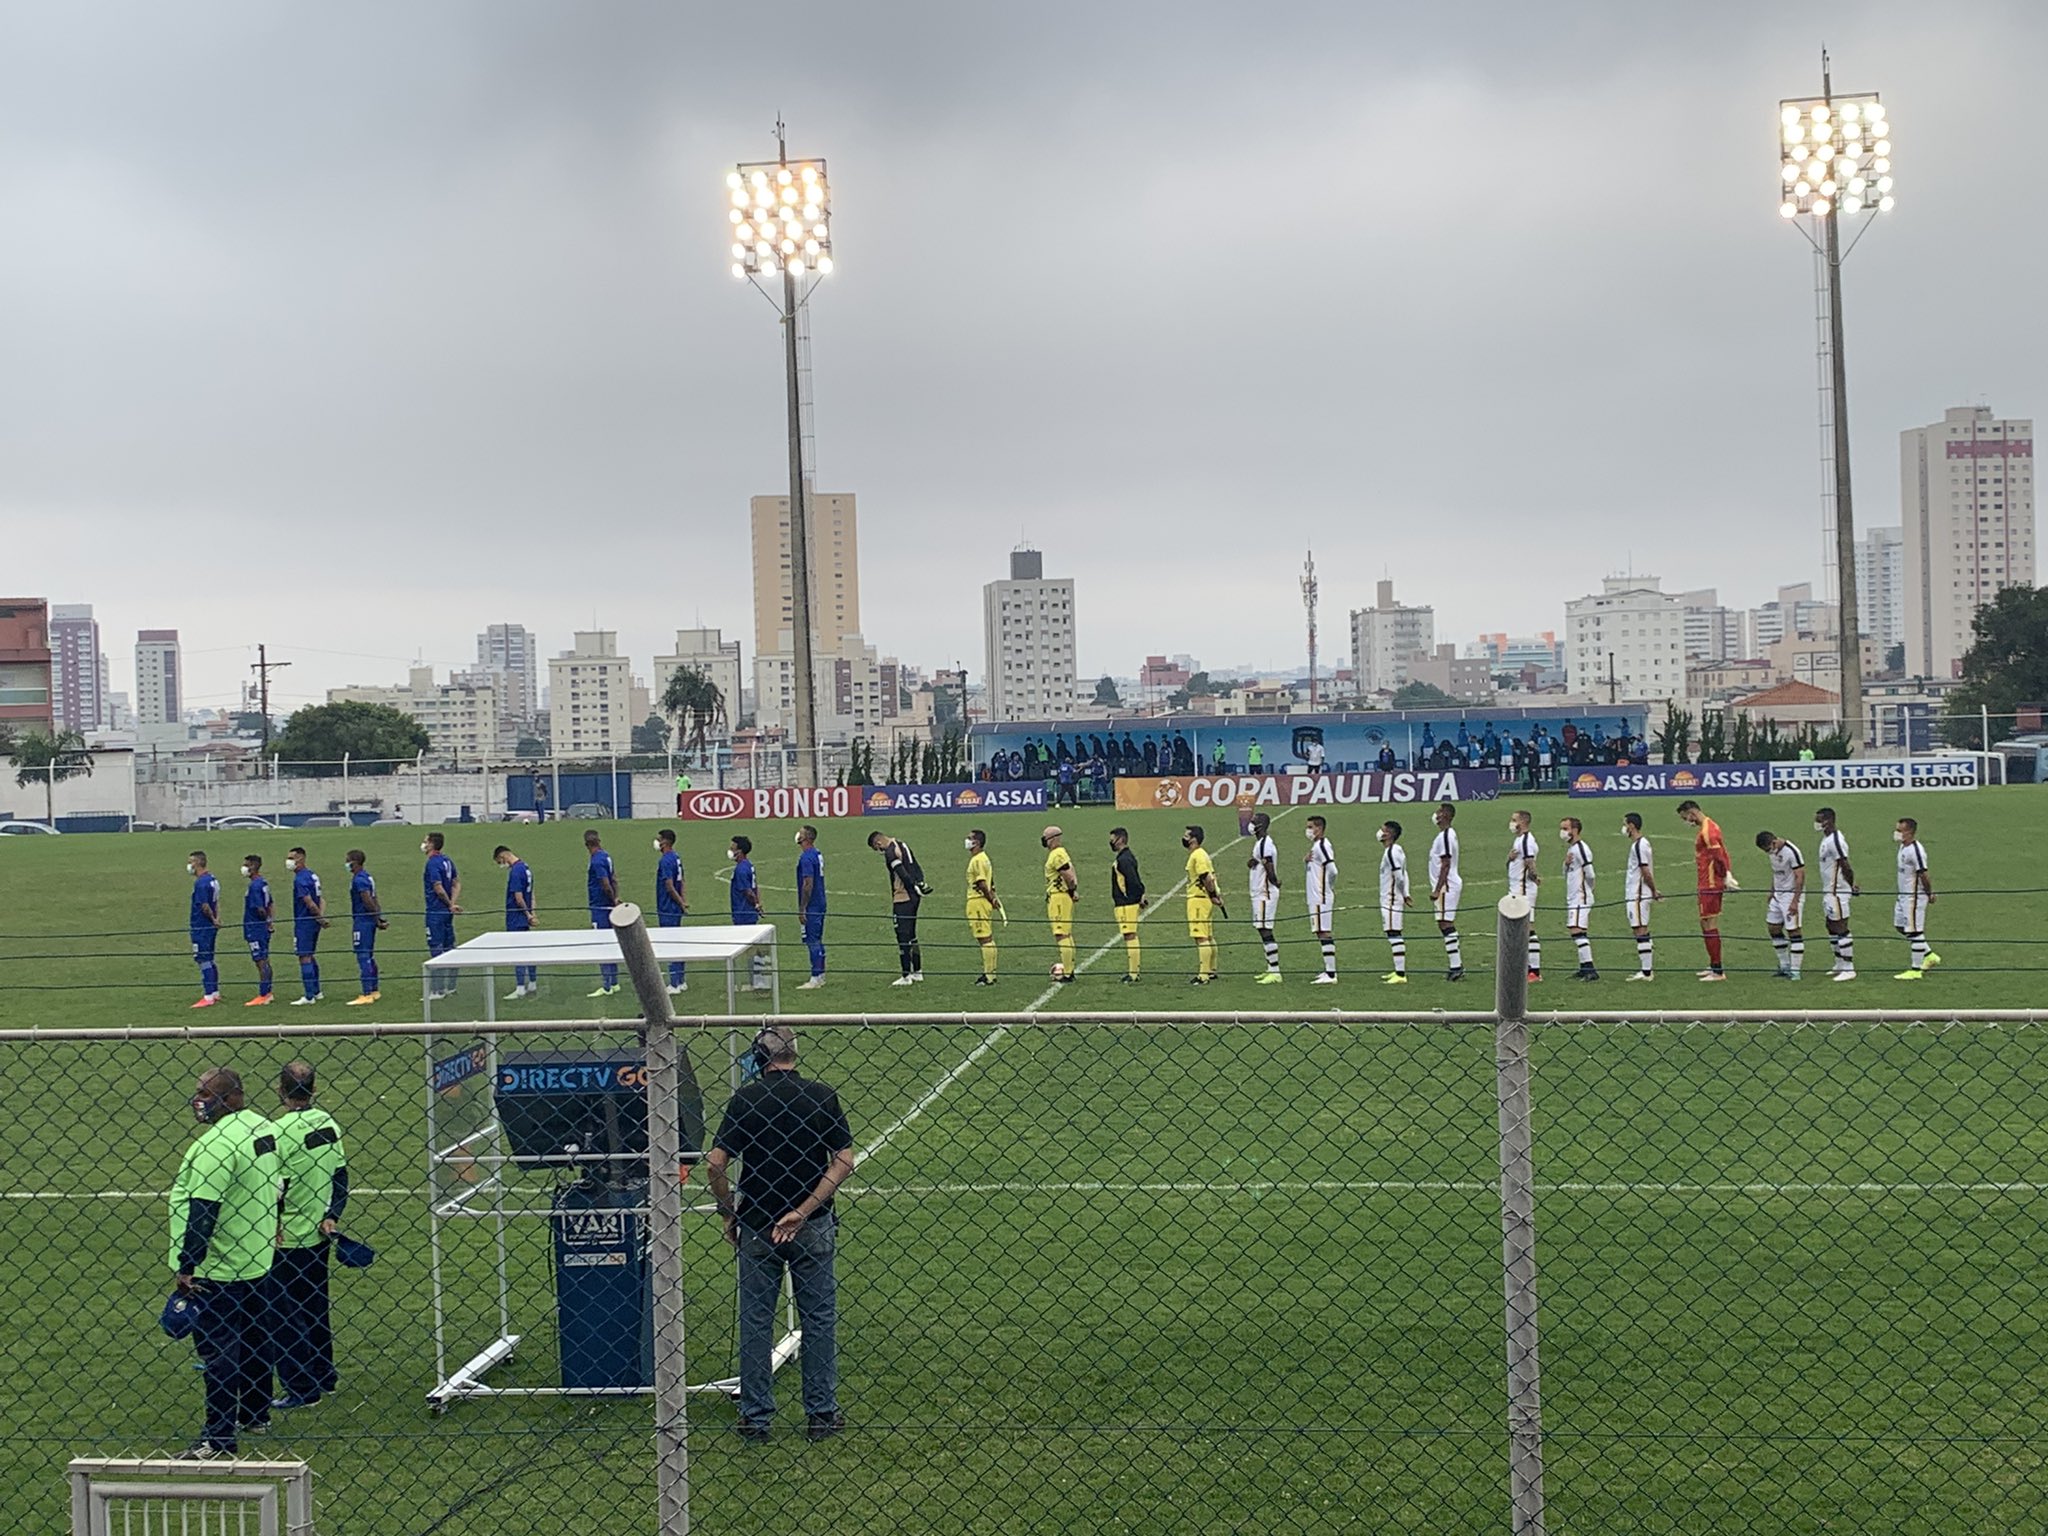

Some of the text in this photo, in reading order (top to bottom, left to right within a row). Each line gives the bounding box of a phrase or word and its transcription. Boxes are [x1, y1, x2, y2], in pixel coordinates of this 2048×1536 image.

[1774, 766, 1834, 778] TEK
[1843, 764, 1904, 777] TEK
[1913, 762, 1974, 776] TEK
[1772, 779, 1835, 791] BOND
[1841, 777, 1905, 789] BOND
[1911, 775, 1975, 788] BOND
[1187, 772, 1460, 807] COPA PAULISTA
[700, 796, 737, 813] KIA
[753, 787, 849, 819] BONGO
[501, 1067, 612, 1091] DIRECTV
[567, 1214, 619, 1234] VAR
